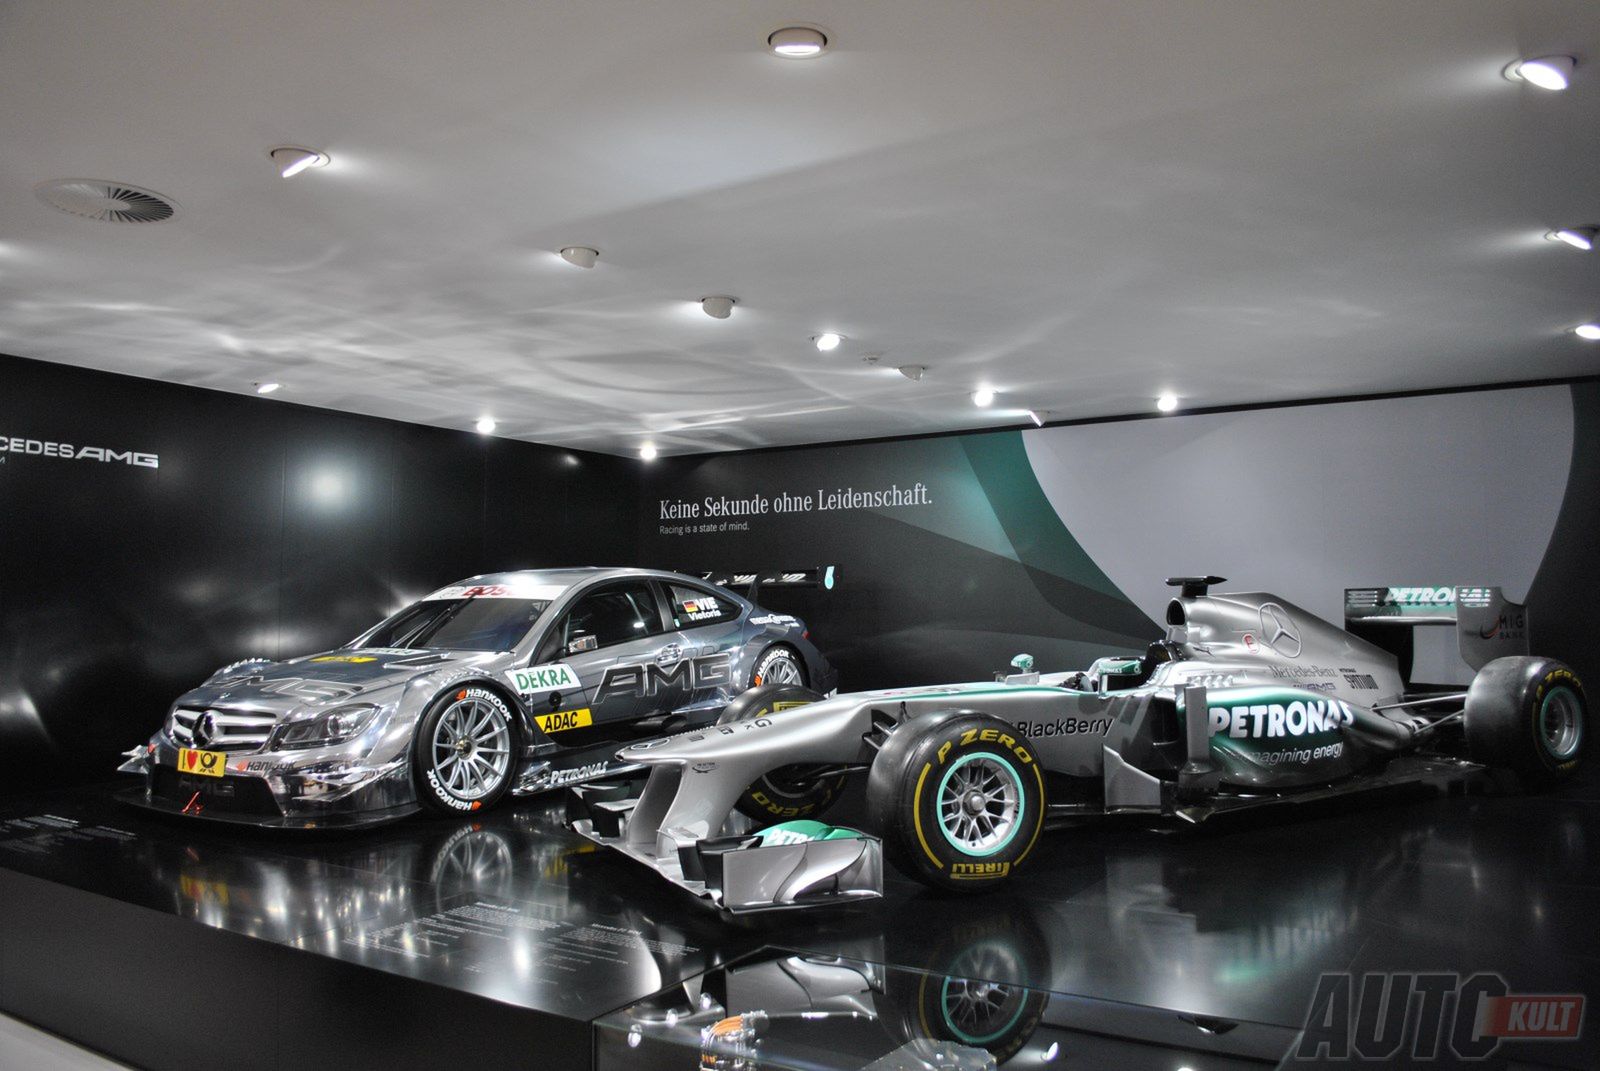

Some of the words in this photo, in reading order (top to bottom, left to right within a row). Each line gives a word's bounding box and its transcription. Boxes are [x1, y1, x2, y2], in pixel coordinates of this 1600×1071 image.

[75, 446, 160, 469] AMG
[659, 499, 701, 520] Keine
[703, 493, 769, 517] Sekunde
[773, 491, 813, 513] ohne
[817, 482, 933, 511] Leidenschaft.
[660, 525, 684, 536] Racing
[684, 523, 691, 533] is
[692, 525, 698, 533] a
[699, 522, 718, 533] state
[719, 521, 727, 531] of
[728, 520, 750, 531] mind.
[693, 596, 719, 611] VIE
[1499, 614, 1525, 630] MIG
[515, 667, 572, 691] DEKRA
[591, 653, 733, 706] AMG
[543, 711, 579, 733] ADAC
[1016, 716, 1115, 741] BlackBerry
[1209, 700, 1355, 738] PETRONAS
[937, 740, 953, 765] P
[959, 728, 1033, 764] ZERO
[1312, 741, 1345, 760] energy
[551, 761, 609, 785] PETRONAS
[950, 862, 1011, 880] PIRELLI
